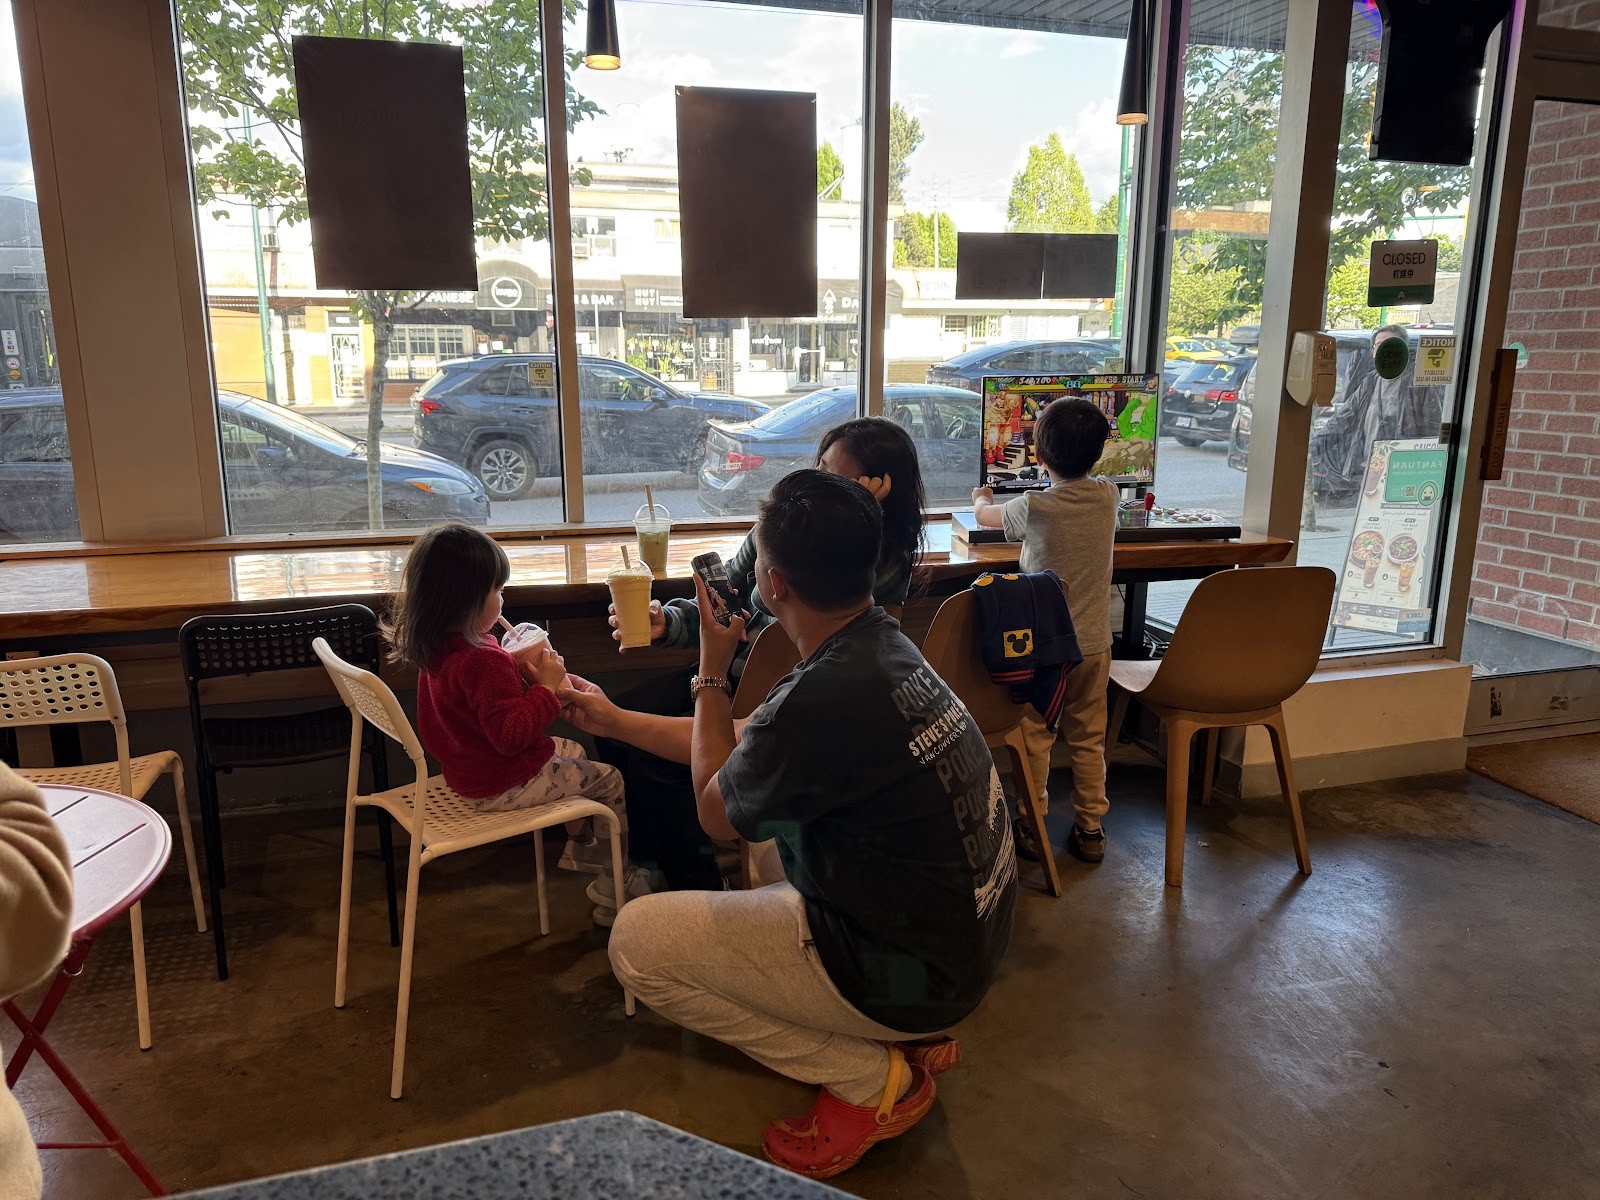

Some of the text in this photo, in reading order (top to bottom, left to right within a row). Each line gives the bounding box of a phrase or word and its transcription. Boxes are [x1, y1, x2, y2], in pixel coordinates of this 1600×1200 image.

[1382, 252, 1426, 266] CLOSED
[590, 294, 614, 305] BAR
[1122, 375, 1144, 384] START
[889, 667, 940, 722] POKE
[908, 718, 949, 757] STEVE'S
